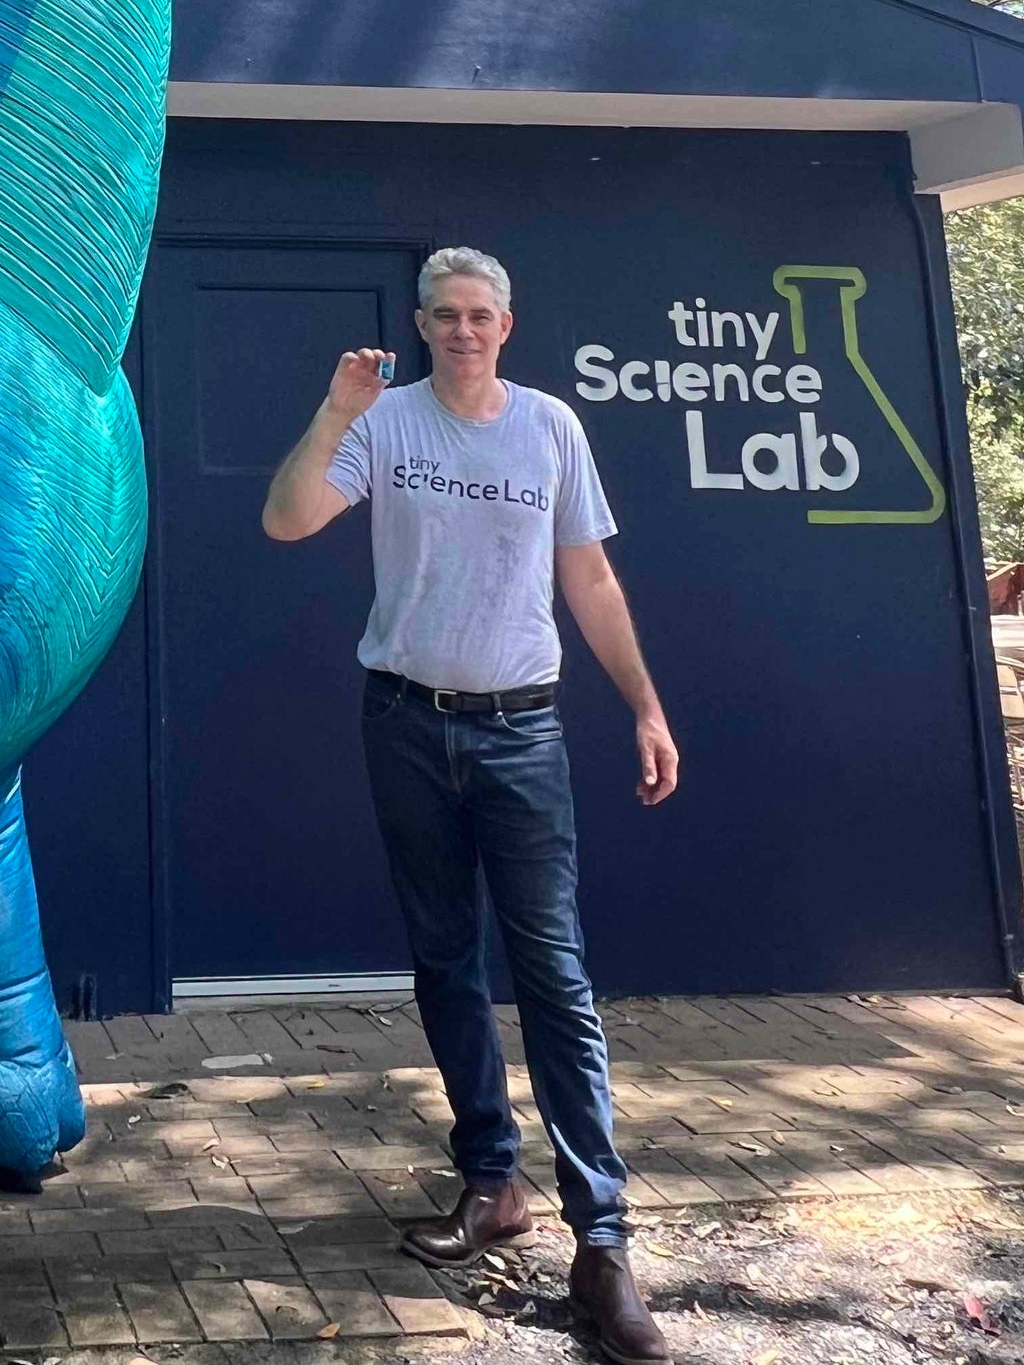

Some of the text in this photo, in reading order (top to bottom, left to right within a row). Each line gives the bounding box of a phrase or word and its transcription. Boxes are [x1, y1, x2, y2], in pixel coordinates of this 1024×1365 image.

[668, 297, 779, 360] tiny
[574, 344, 822, 403] Science
[409, 455, 440, 474] tiny
[685, 410, 860, 491] Lab
[392, 465, 549, 512] Science Lab
